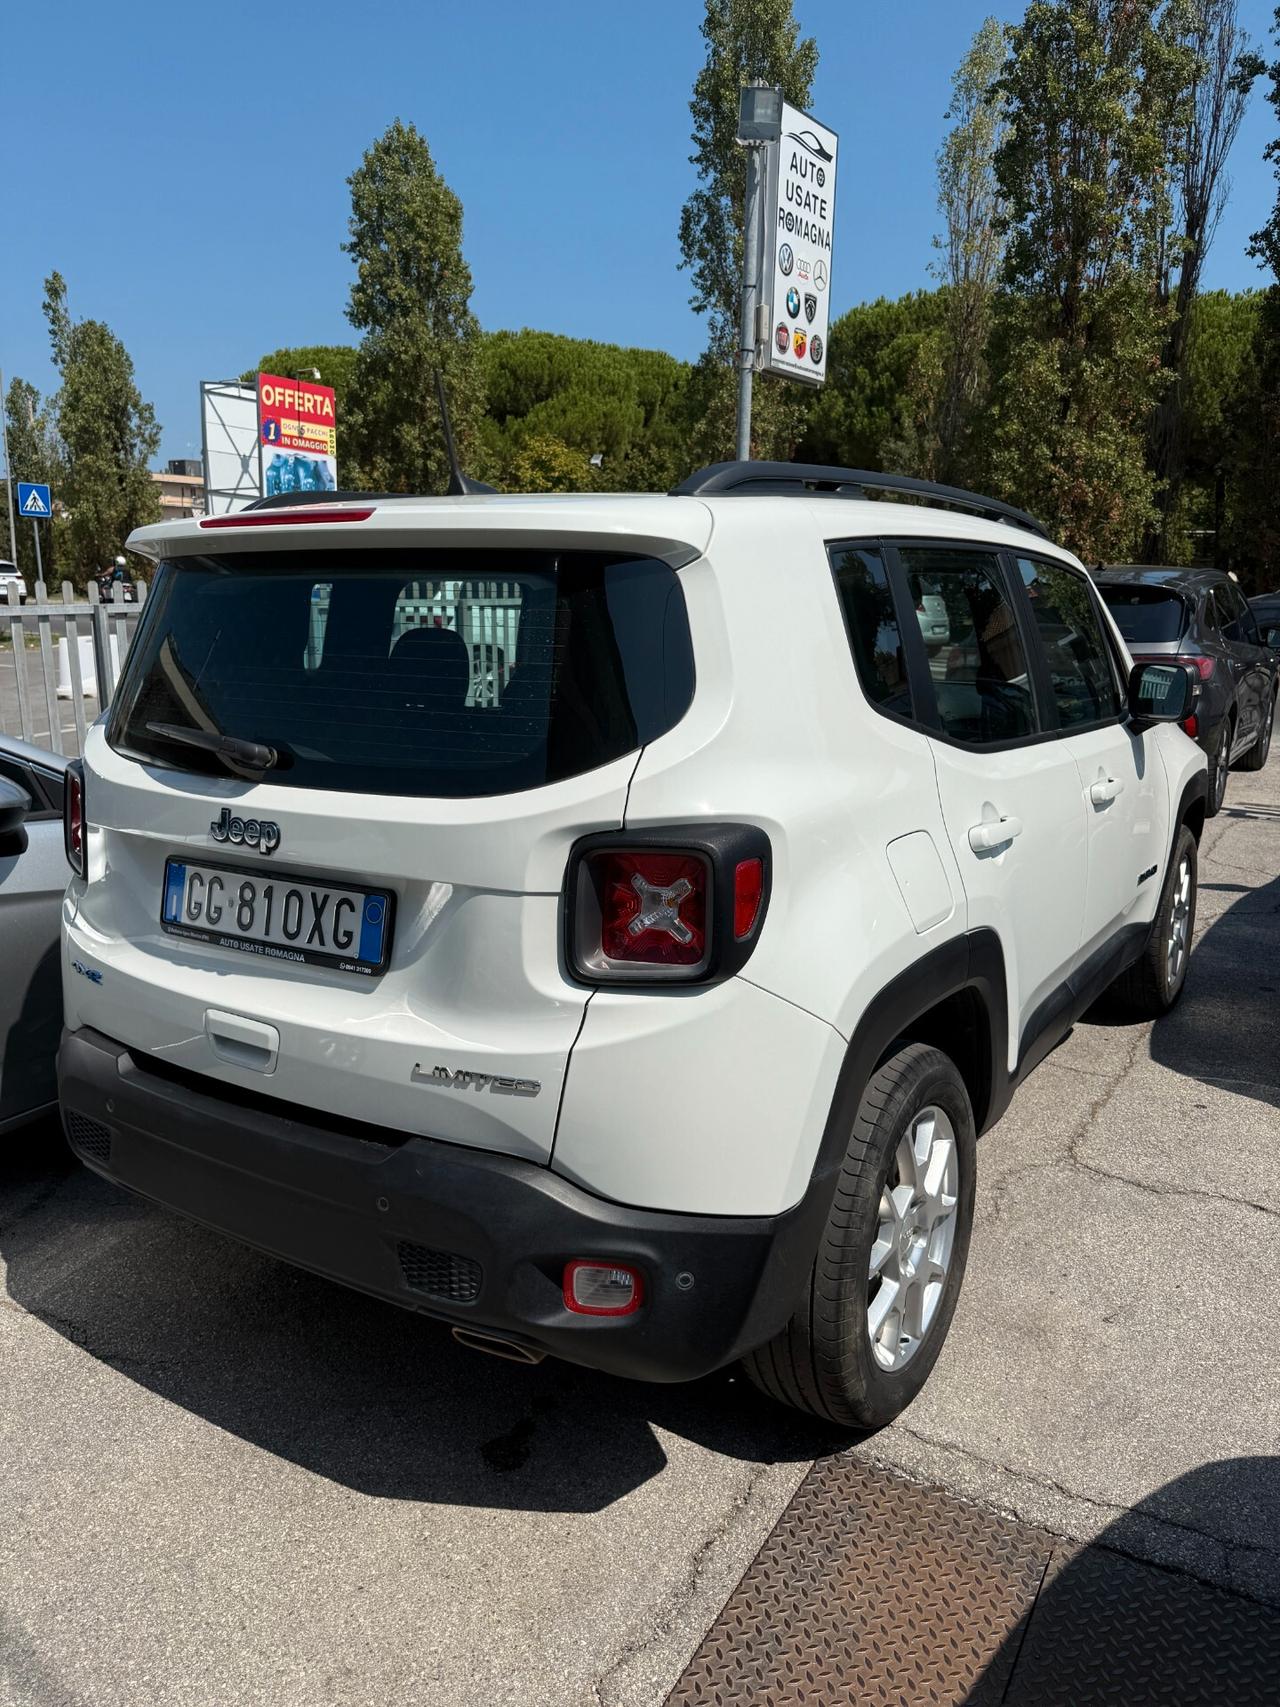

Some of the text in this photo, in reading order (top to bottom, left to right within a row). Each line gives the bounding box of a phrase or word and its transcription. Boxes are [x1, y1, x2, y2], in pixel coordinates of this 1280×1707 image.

[790, 152, 825, 188] AUTO
[786, 179, 827, 220] USATE
[779, 207, 831, 251] ROMAGNA
[262, 384, 334, 417] OFFERTA
[268, 422, 276, 440] 1
[282, 437, 328, 451] IN OMAGGIO
[211, 808, 281, 855] Jeep
[220, 938, 305, 962] AUTO USATE ROMAGNA
[410, 1062, 542, 1092] LIMITED
